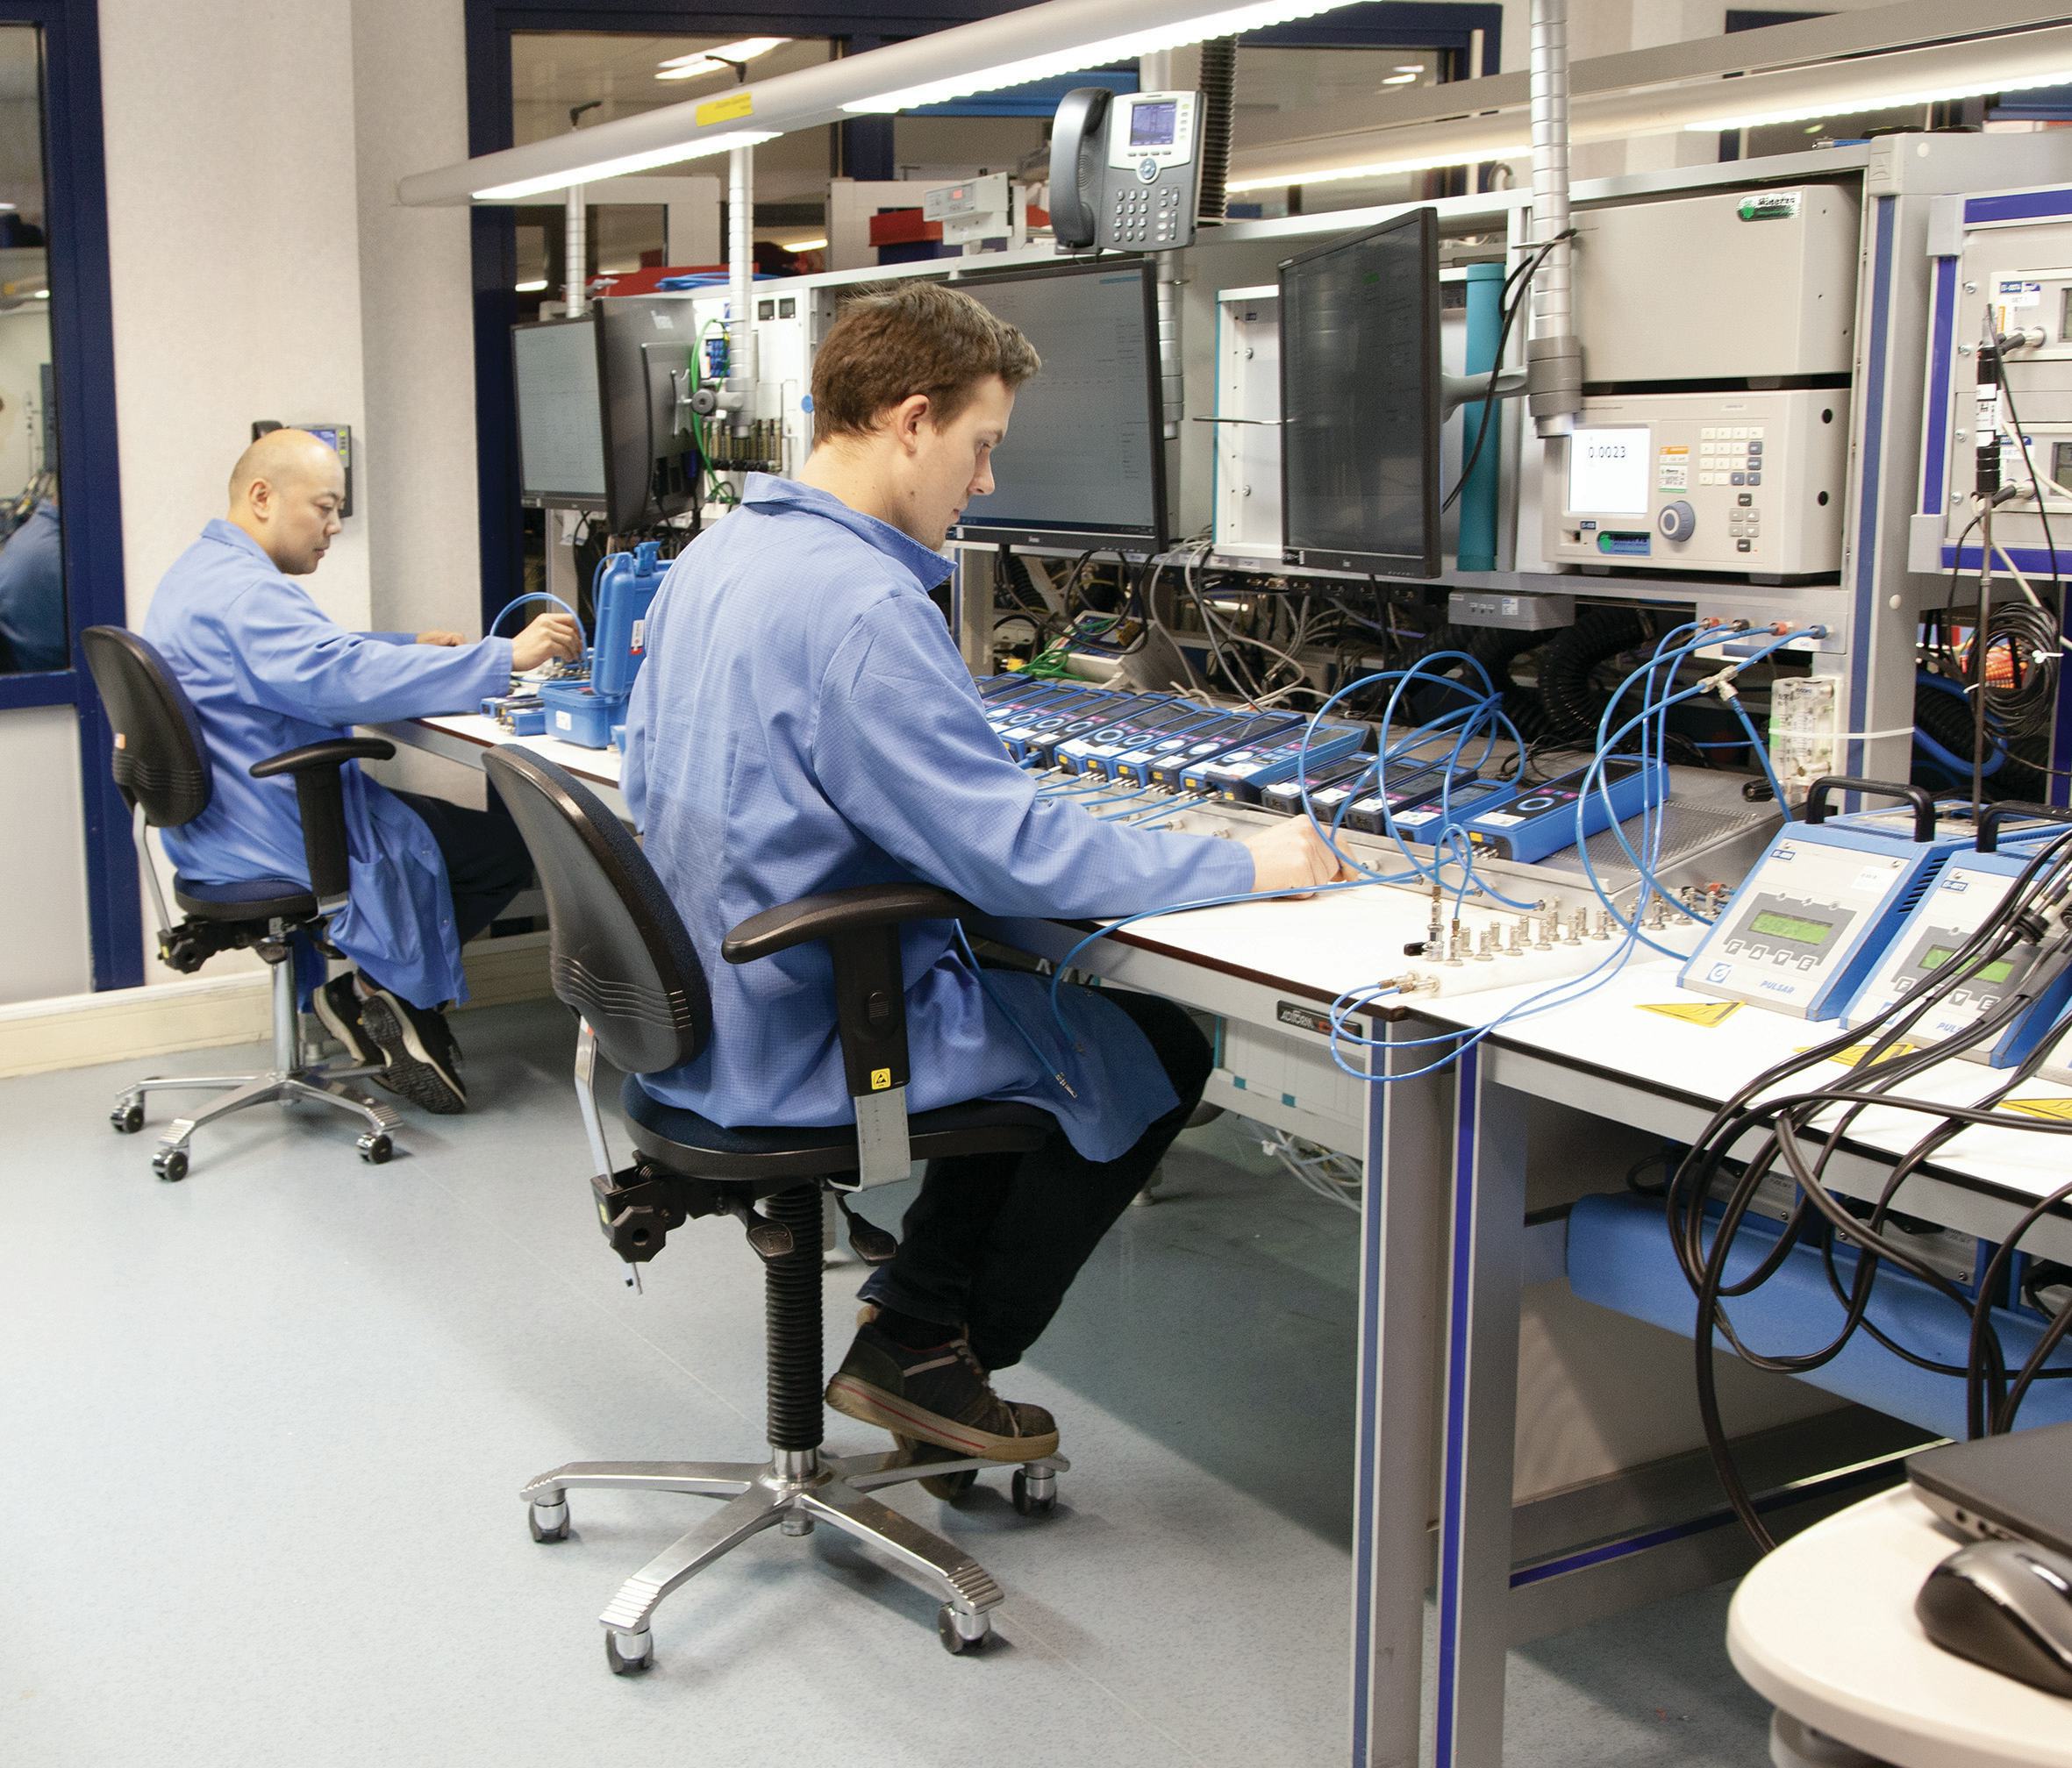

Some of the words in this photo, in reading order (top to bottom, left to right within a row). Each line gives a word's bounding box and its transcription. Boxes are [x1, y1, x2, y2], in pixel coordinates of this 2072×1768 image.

[1589, 446, 1625, 458] 0.0023
[1801, 959, 1813, 969] E
[1761, 980, 1796, 994] PULSAR
